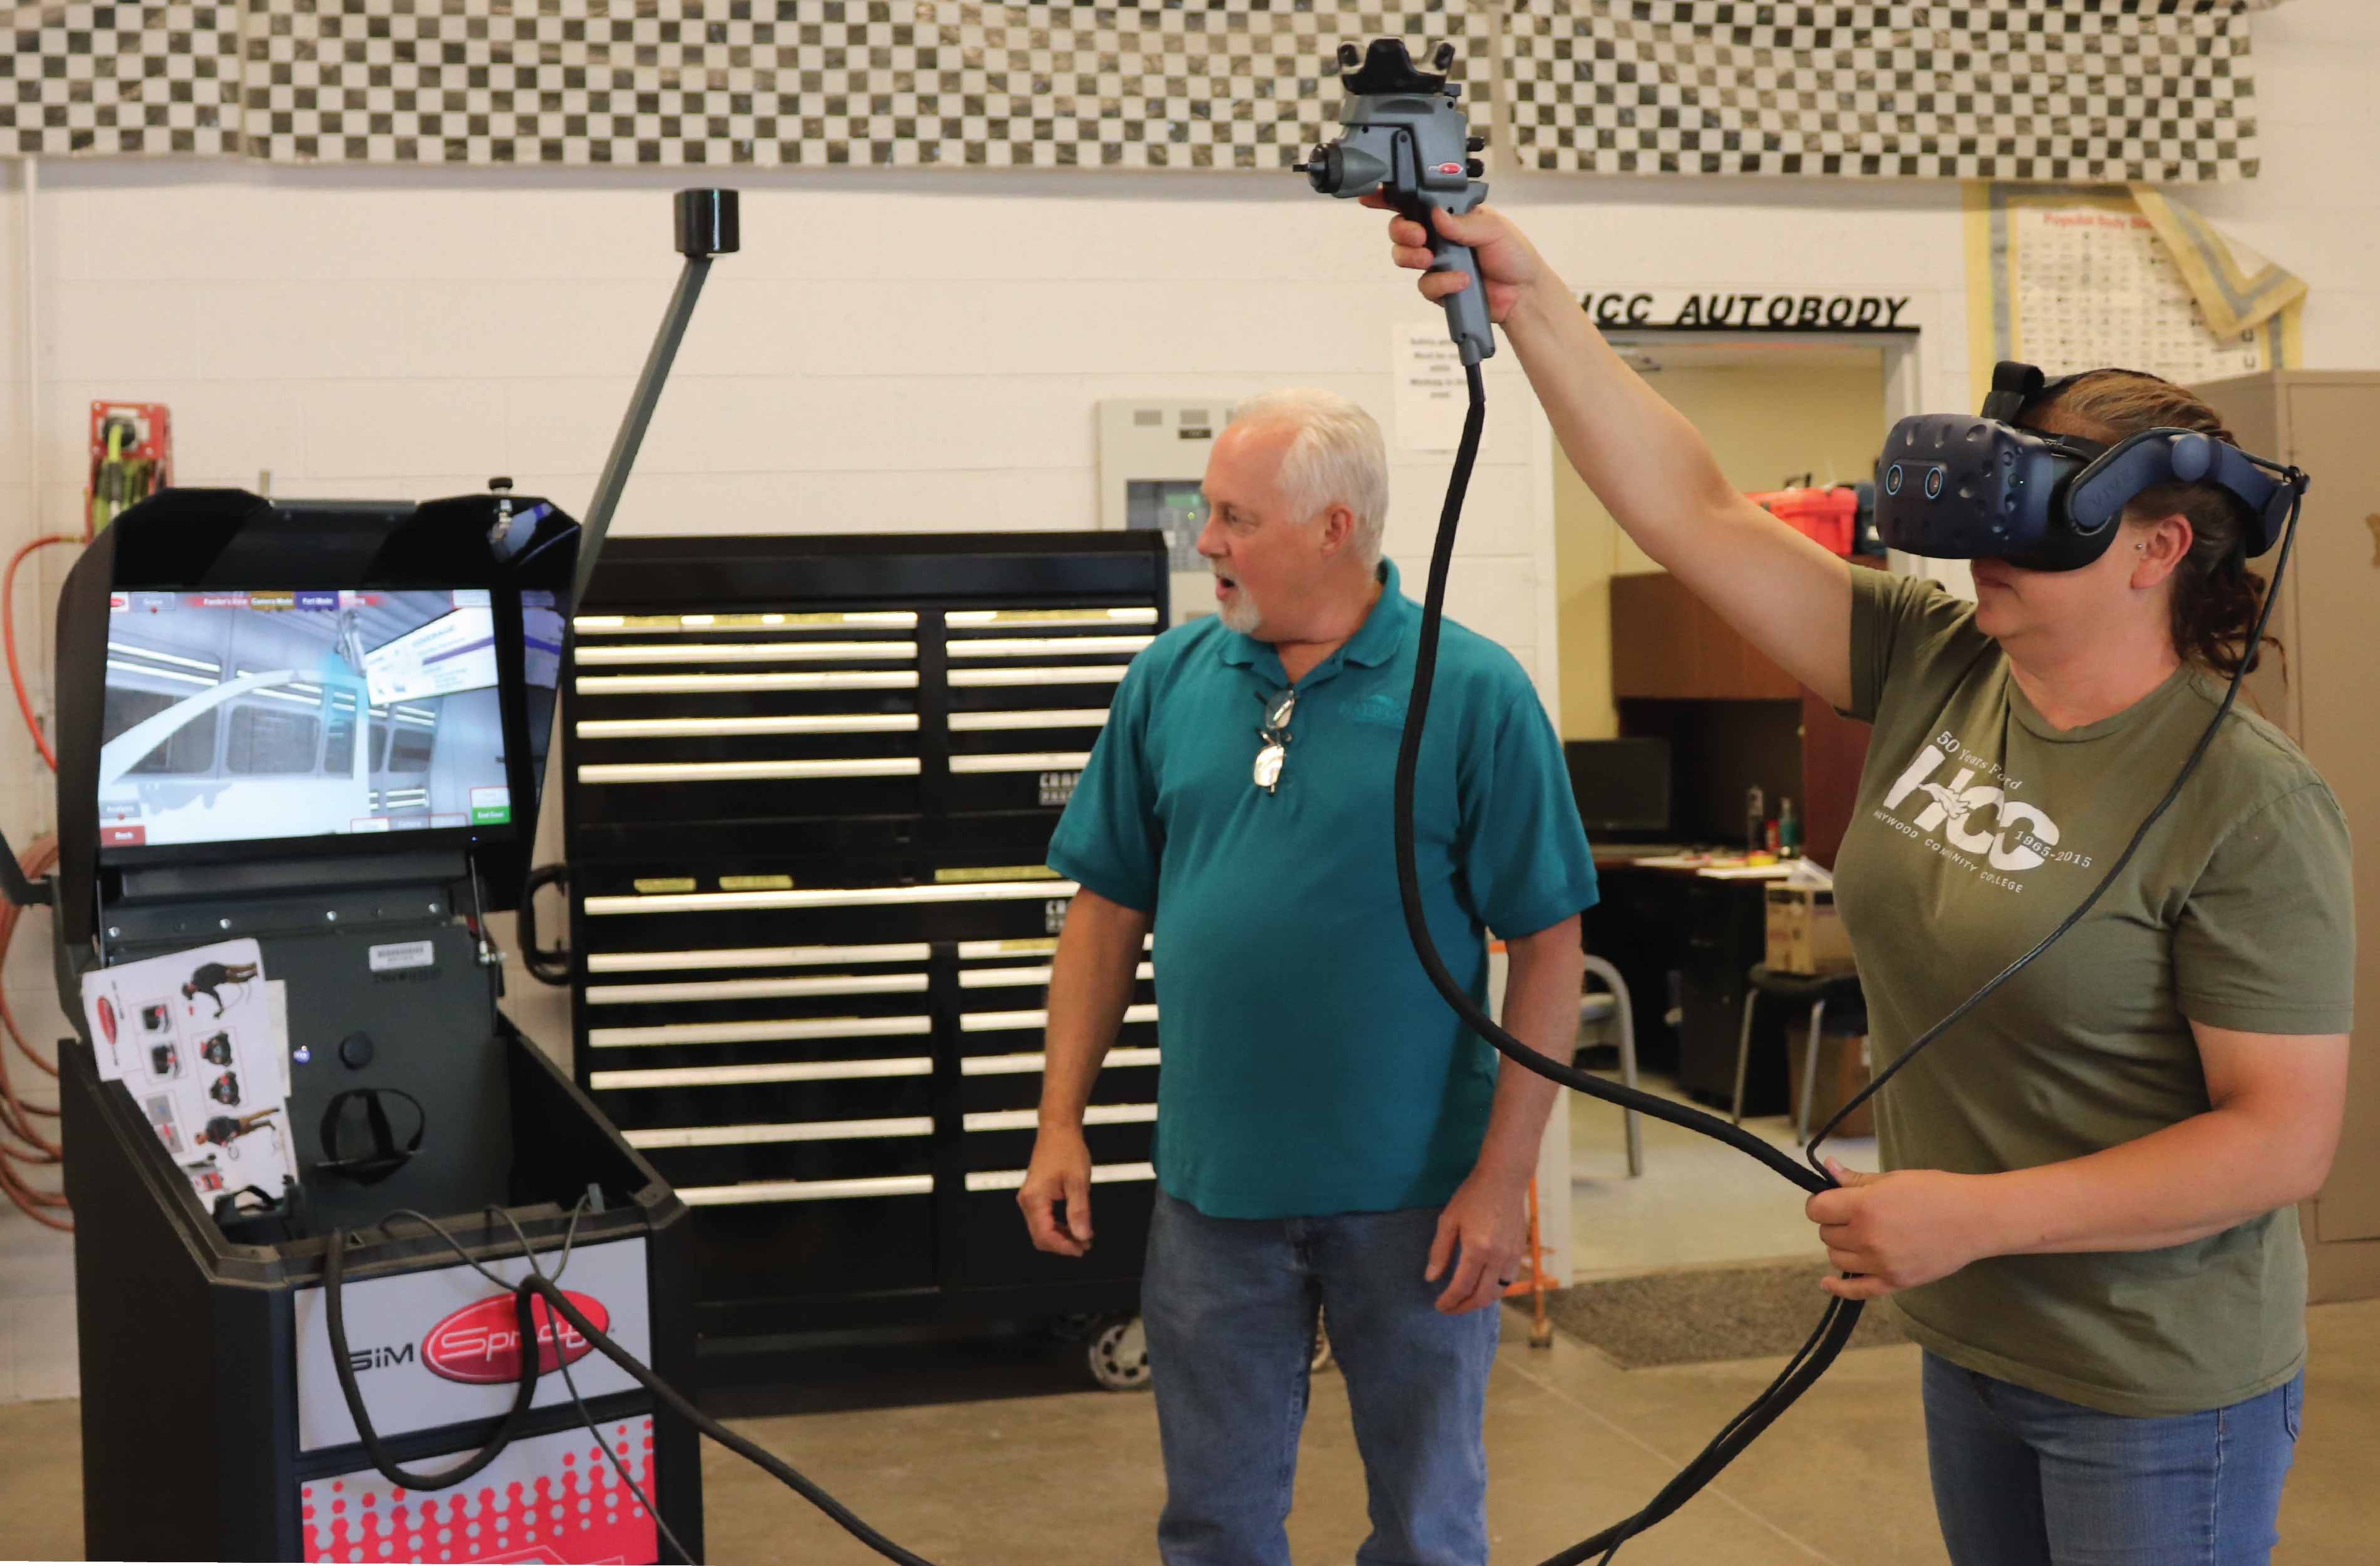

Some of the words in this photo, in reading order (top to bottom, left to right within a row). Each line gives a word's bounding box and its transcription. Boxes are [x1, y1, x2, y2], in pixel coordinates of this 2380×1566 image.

[1675, 293, 1912, 325] AUTOBODY
[1937, 730, 1961, 753] 50
[1958, 749, 1989, 770] Years
[1882, 744, 2061, 871] HCC
[2014, 830, 2093, 869] 1965-2015
[349, 1342, 413, 1372] SiM
